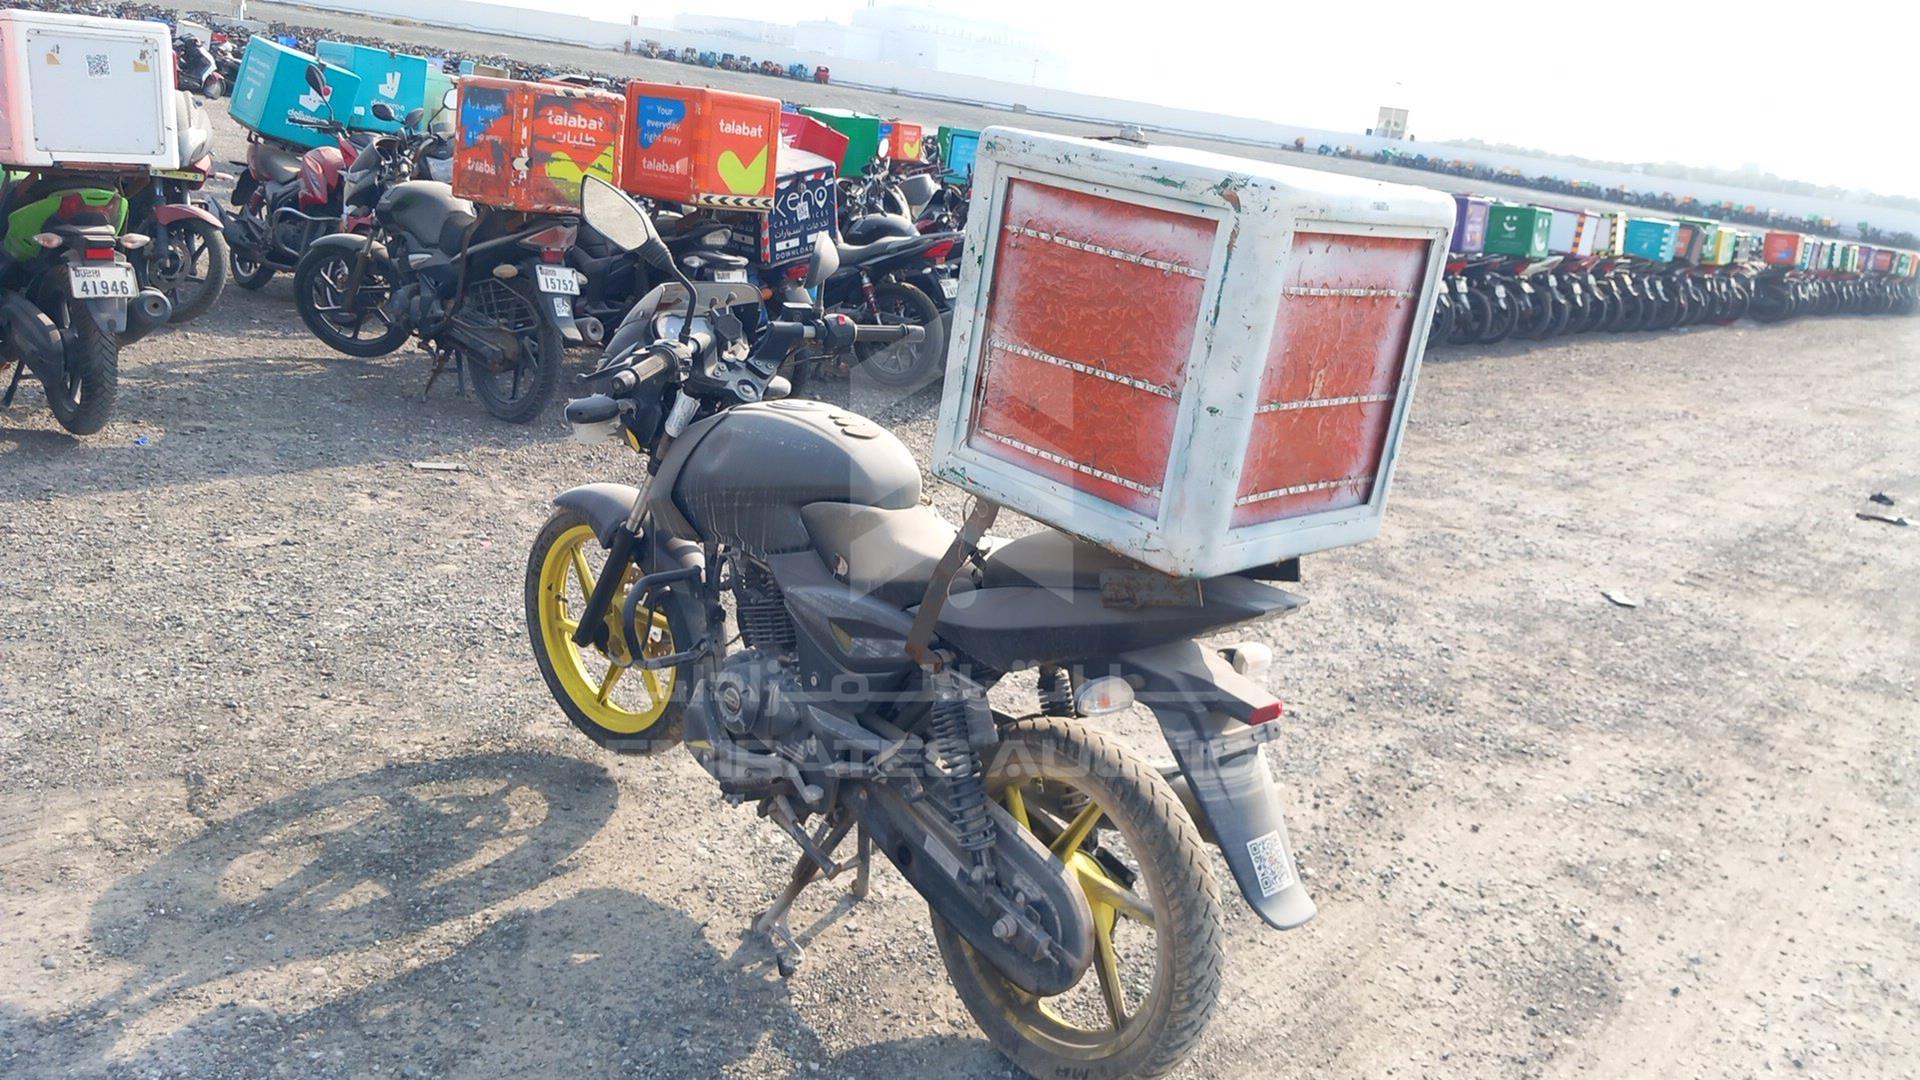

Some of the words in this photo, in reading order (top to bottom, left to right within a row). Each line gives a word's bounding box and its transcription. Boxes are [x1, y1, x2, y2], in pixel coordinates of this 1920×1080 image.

[656, 104, 674, 116] Your
[547, 109, 604, 132] talabat
[719, 118, 764, 139] talabat
[643, 131, 661, 144] right
[662, 134, 682, 147] away
[775, 245, 814, 261] DOWNLOAD
[81, 280, 129, 296] 41946
[545, 277, 575, 292] 15752
